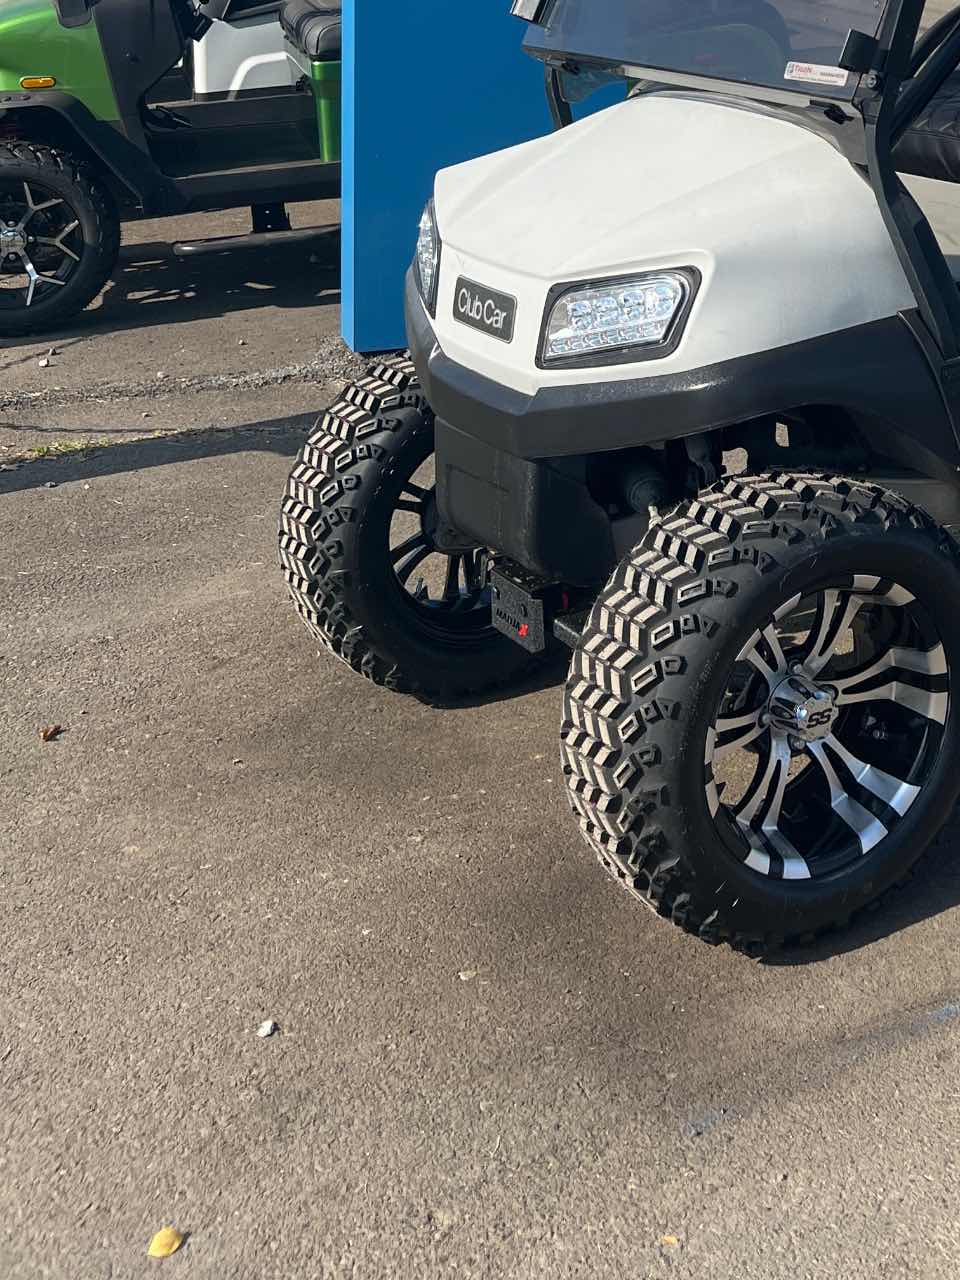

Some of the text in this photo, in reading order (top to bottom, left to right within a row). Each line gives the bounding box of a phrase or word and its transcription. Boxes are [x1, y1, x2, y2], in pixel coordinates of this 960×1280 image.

[458, 287, 507, 329] Club Car
[806, 707, 833, 729] SS
